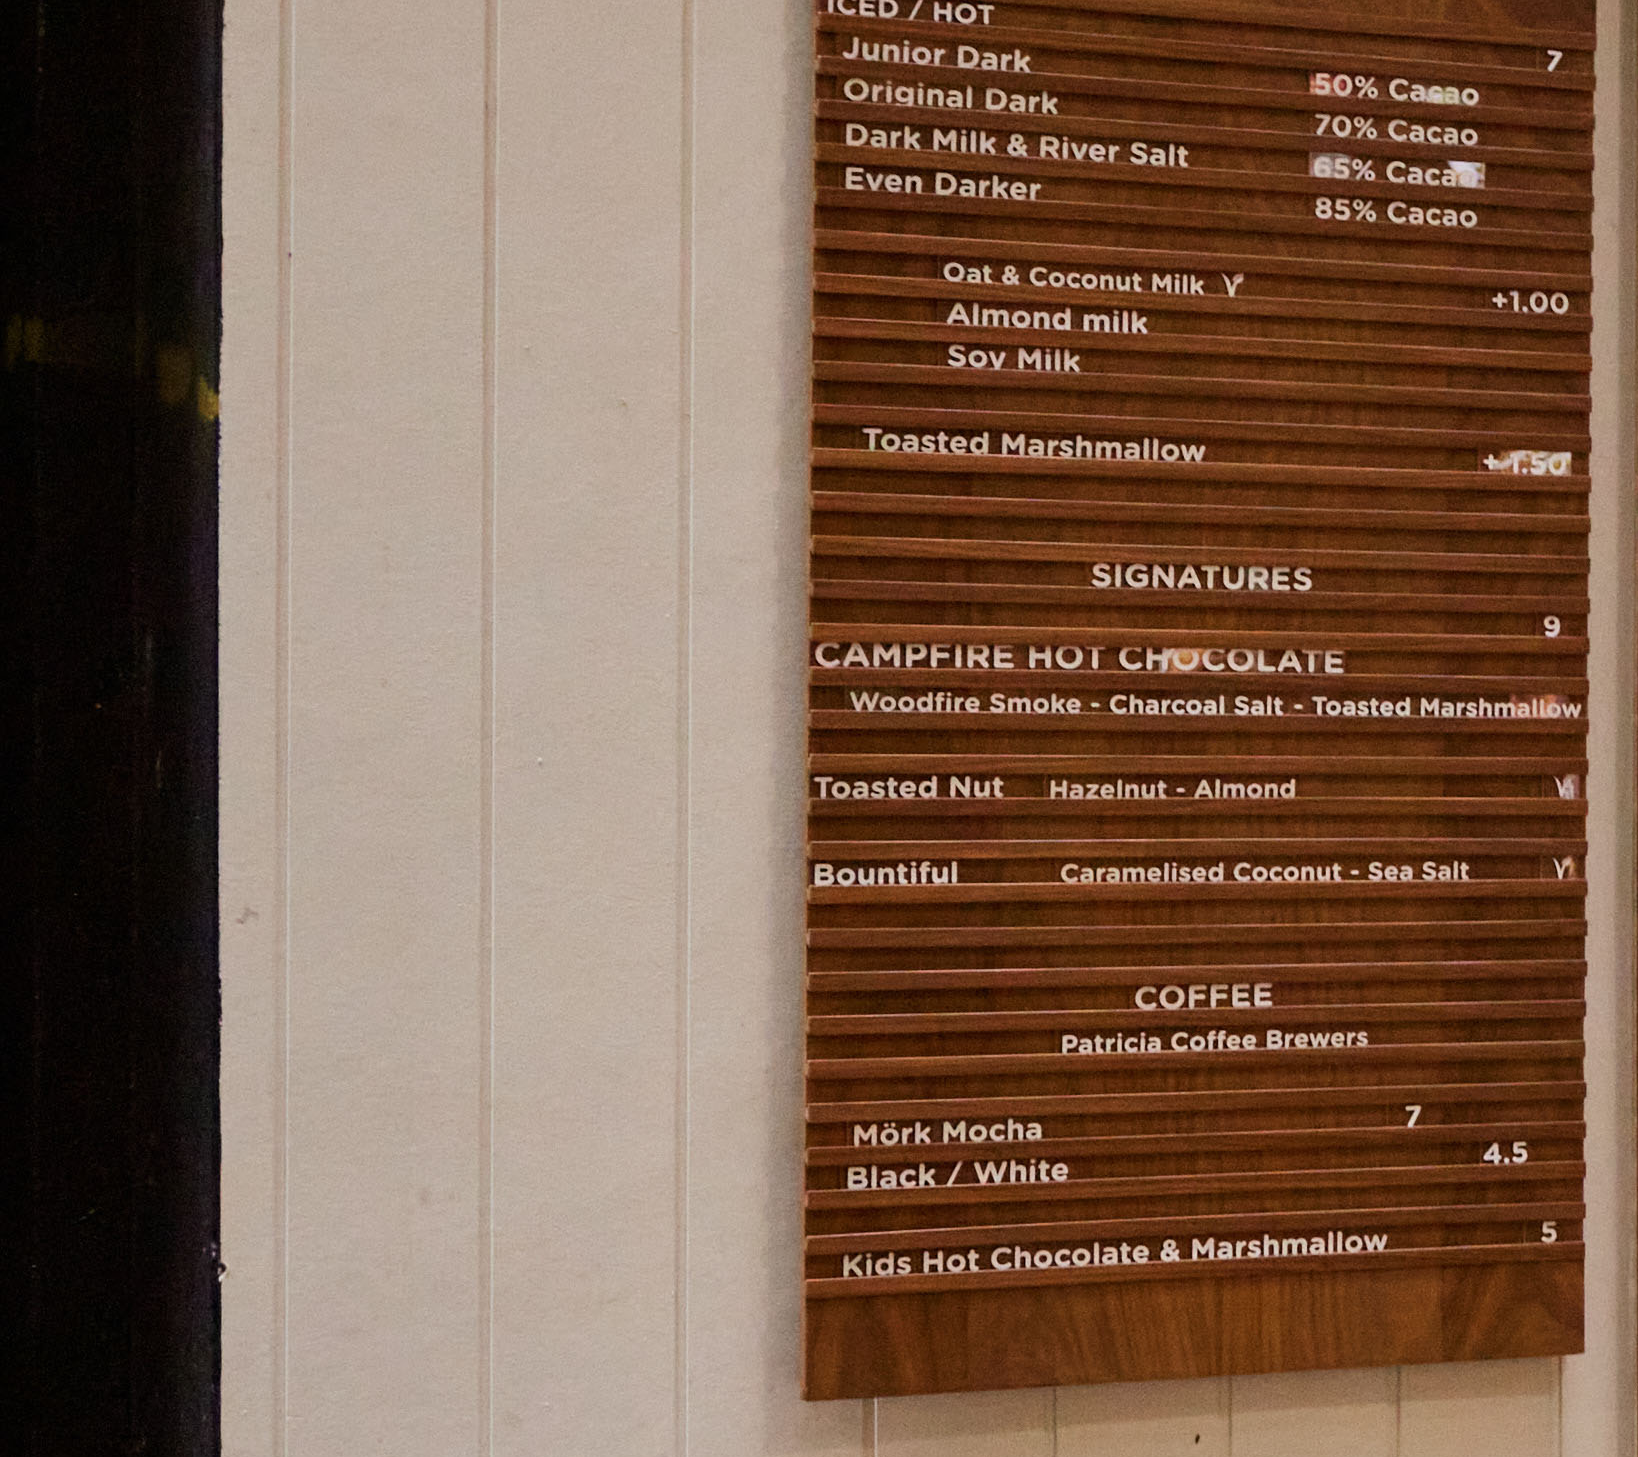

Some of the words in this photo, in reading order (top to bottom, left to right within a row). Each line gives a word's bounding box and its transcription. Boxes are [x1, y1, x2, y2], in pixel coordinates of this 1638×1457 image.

[933, 1, 995, 26] HOT
[842, 36, 946, 67] Junior
[956, 45, 1033, 74] Dark
[1547, 49, 1563, 73] 7
[843, 78, 973, 109] Original
[985, 88, 1058, 115] Dark
[1310, 72, 1379, 100] 50%
[1388, 78, 1480, 107] Cacao
[1315, 113, 1378, 140] 70%
[1387, 119, 1479, 147] Cacao
[845, 123, 921, 152] Dark
[932, 128, 997, 156] Milk
[1006, 133, 1029, 158] &
[1039, 135, 1121, 164] River
[1129, 142, 1189, 168] Salt
[845, 166, 923, 195] Even
[934, 173, 1042, 202] Darker
[1310, 153, 1376, 182] 65%
[1386, 160, 1483, 189] Cacao
[1314, 197, 1377, 223] 85%
[1386, 201, 1478, 229] Cacao
[943, 262, 994, 285] Oat
[1001, 265, 1020, 286] &
[1029, 266, 1143, 293] Coconut
[1151, 273, 1205, 296] Milk
[1491, 290, 1570, 315] +1.00
[946, 303, 1072, 331] Almond
[1082, 310, 1149, 335] milk
[1012, 348, 1081, 374] Milk
[858, 428, 994, 458] Toasted
[996, 433, 1206, 465] Marshmallow
[1091, 563, 1313, 592] SIGNATURES
[1543, 616, 1561, 639] 9
[810, 643, 1015, 672] CAMPFIRE
[1028, 646, 1106, 670] HOT
[1118, 647, 1345, 675] CHOCOLATE
[849, 691, 984, 714] Woodfire
[986, 693, 1083, 715] Smoke
[1109, 694, 1229, 716] Charcoal
[1233, 695, 1284, 717] Salt
[1311, 696, 1411, 718] Toasted
[1420, 697, 1582, 719] Marshmallow
[813, 775, 942, 800] Toasted
[949, 776, 1004, 800] Nut
[1049, 779, 1168, 800] Hazelnut
[1193, 778, 1296, 800] Almond
[813, 861, 963, 888] Bountiful
[1057, 861, 1231, 886] Caramelised
[1231, 862, 1346, 884] Coconut
[1364, 861, 1417, 883] Sea
[1417, 860, 1473, 883] Salt
[1133, 982, 1273, 1012] COFFEE
[1058, 1031, 1165, 1057] Patricia
[1167, 1029, 1261, 1054] Coffee
[1265, 1029, 1369, 1051] Brewers
[1405, 1105, 1422, 1129] 7
[853, 1121, 931, 1148] Mörk
[942, 1118, 1043, 1145] Mocha
[1483, 1141, 1529, 1166] 4.5
[844, 1163, 941, 1192] Black
[973, 1159, 1069, 1187] White
[1540, 1221, 1558, 1245] 5
[839, 1252, 918, 1281] Kids
[919, 1249, 984, 1276] Hot
[988, 1242, 1154, 1272] Chocolate
[1160, 1239, 1183, 1264] &
[1190, 1231, 1392, 1262] Marshmallow
